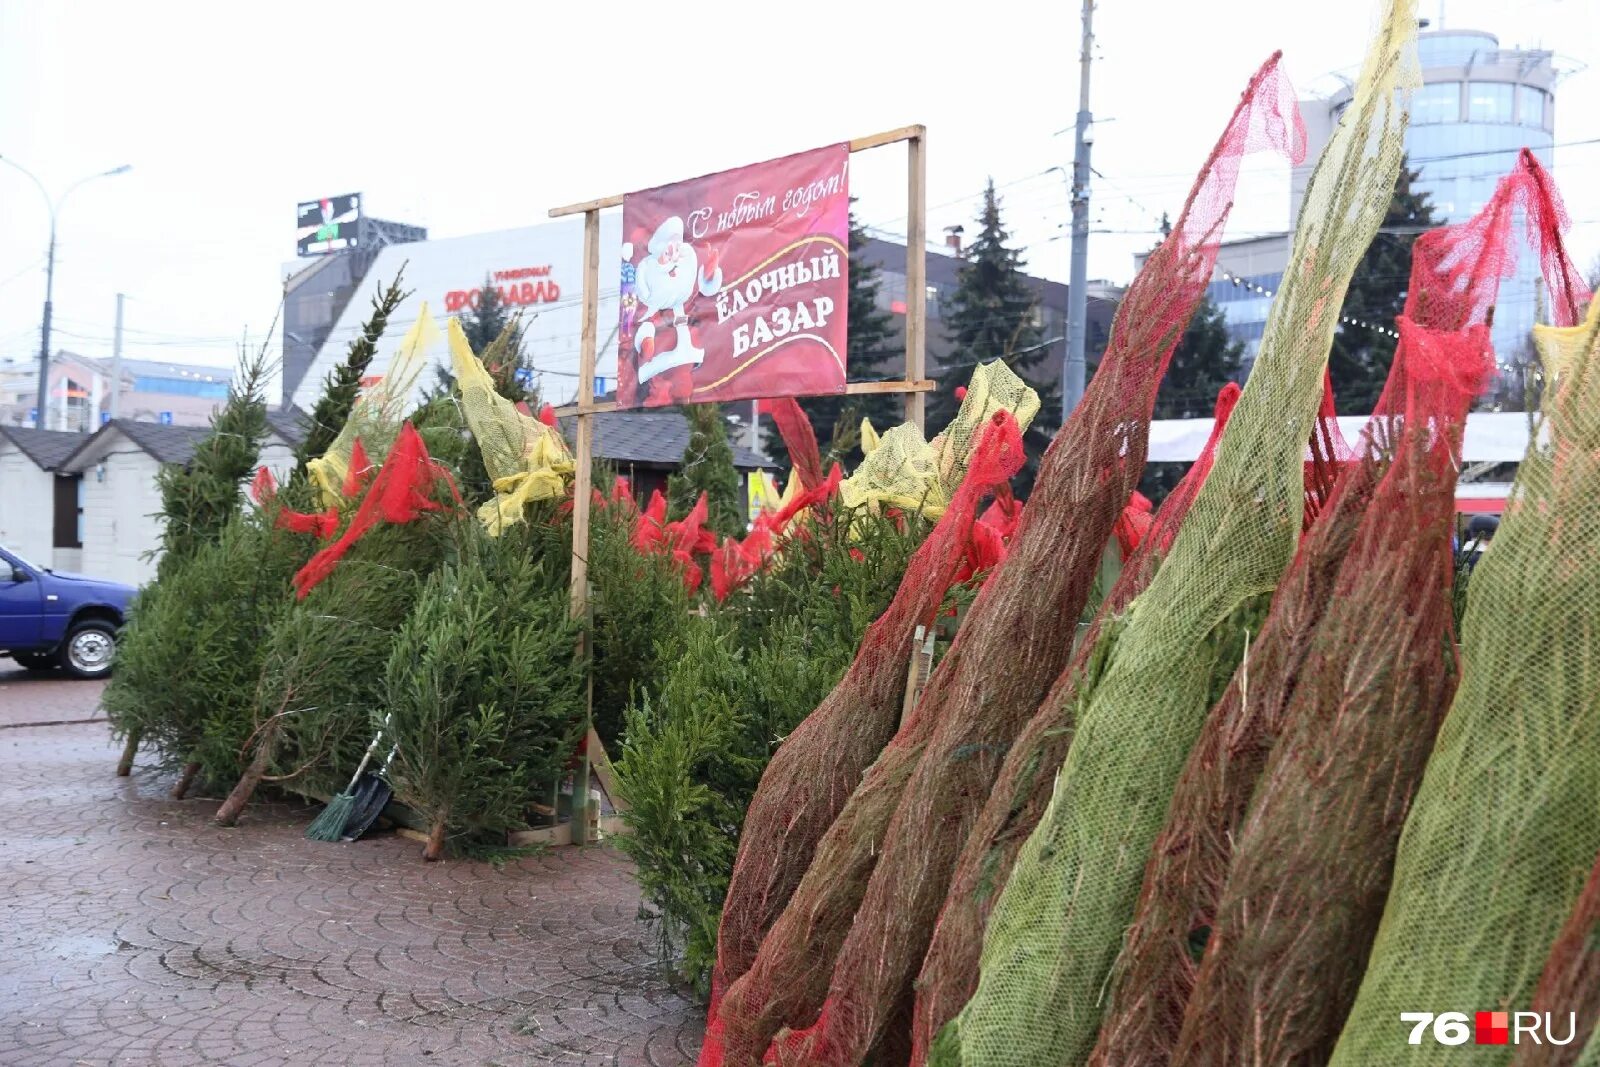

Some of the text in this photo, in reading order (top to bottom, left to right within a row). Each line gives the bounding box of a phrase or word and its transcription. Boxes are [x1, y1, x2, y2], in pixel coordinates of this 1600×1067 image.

[687, 161, 848, 238] С новым годом!
[445, 280, 560, 312] ЯРОЛАВЛЬ
[715, 248, 840, 325] ЁЛОЧНЫЙ
[732, 297, 834, 358] БАЗАР
